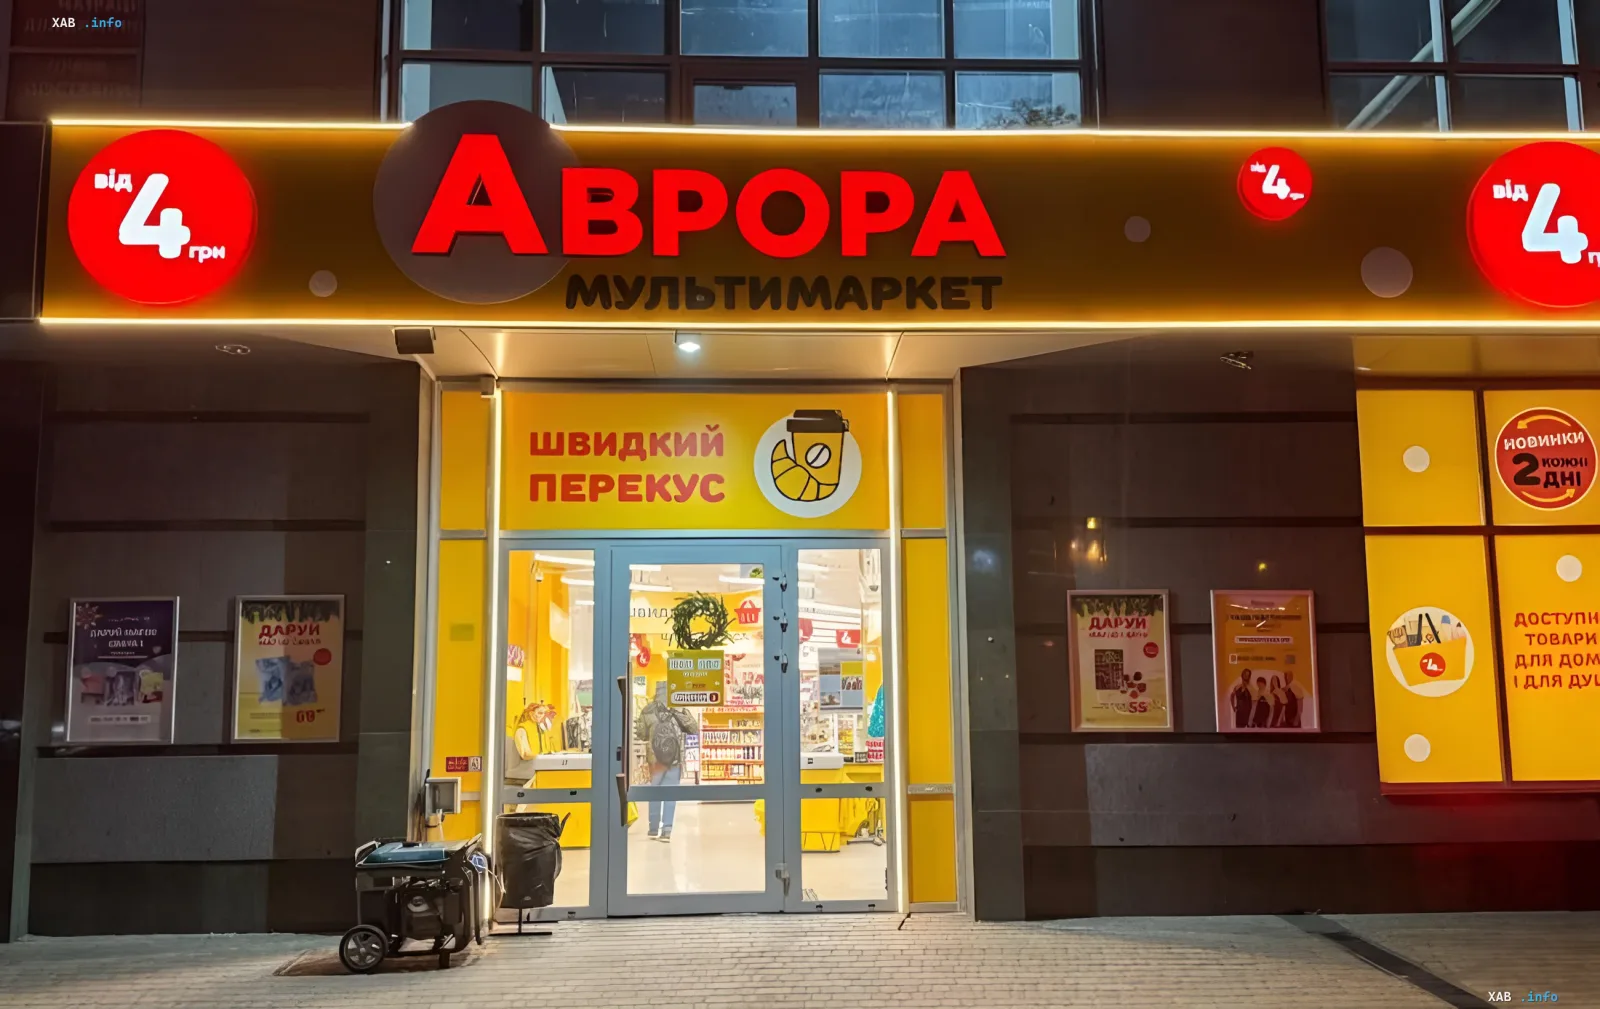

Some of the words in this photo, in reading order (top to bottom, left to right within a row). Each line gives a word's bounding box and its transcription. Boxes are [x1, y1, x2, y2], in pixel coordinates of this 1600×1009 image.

[94, 169, 133, 192] від
[1262, 164, 1291, 200] 4
[1493, 180, 1529, 202] від
[411, 134, 1007, 258] АВРОРА
[118, 173, 191, 259] 4
[1522, 183, 1589, 264] 4
[189, 245, 226, 263] грн
[565, 273, 1003, 311] МУЛЬТИМАРКЕТ
[529, 424, 725, 462] ШВИДКИЙ
[1503, 431, 1585, 451] НОВИНКИ
[1512, 452, 1541, 486] 2
[1543, 471, 1581, 489] ДНІ
[529, 473, 726, 503] ПЕРЕКУС
[1524, 632, 1598, 646] ТОВАРИ
[1515, 654, 1553, 670] ДЛЯ
[1523, 674, 1563, 690] ДЛЯ
